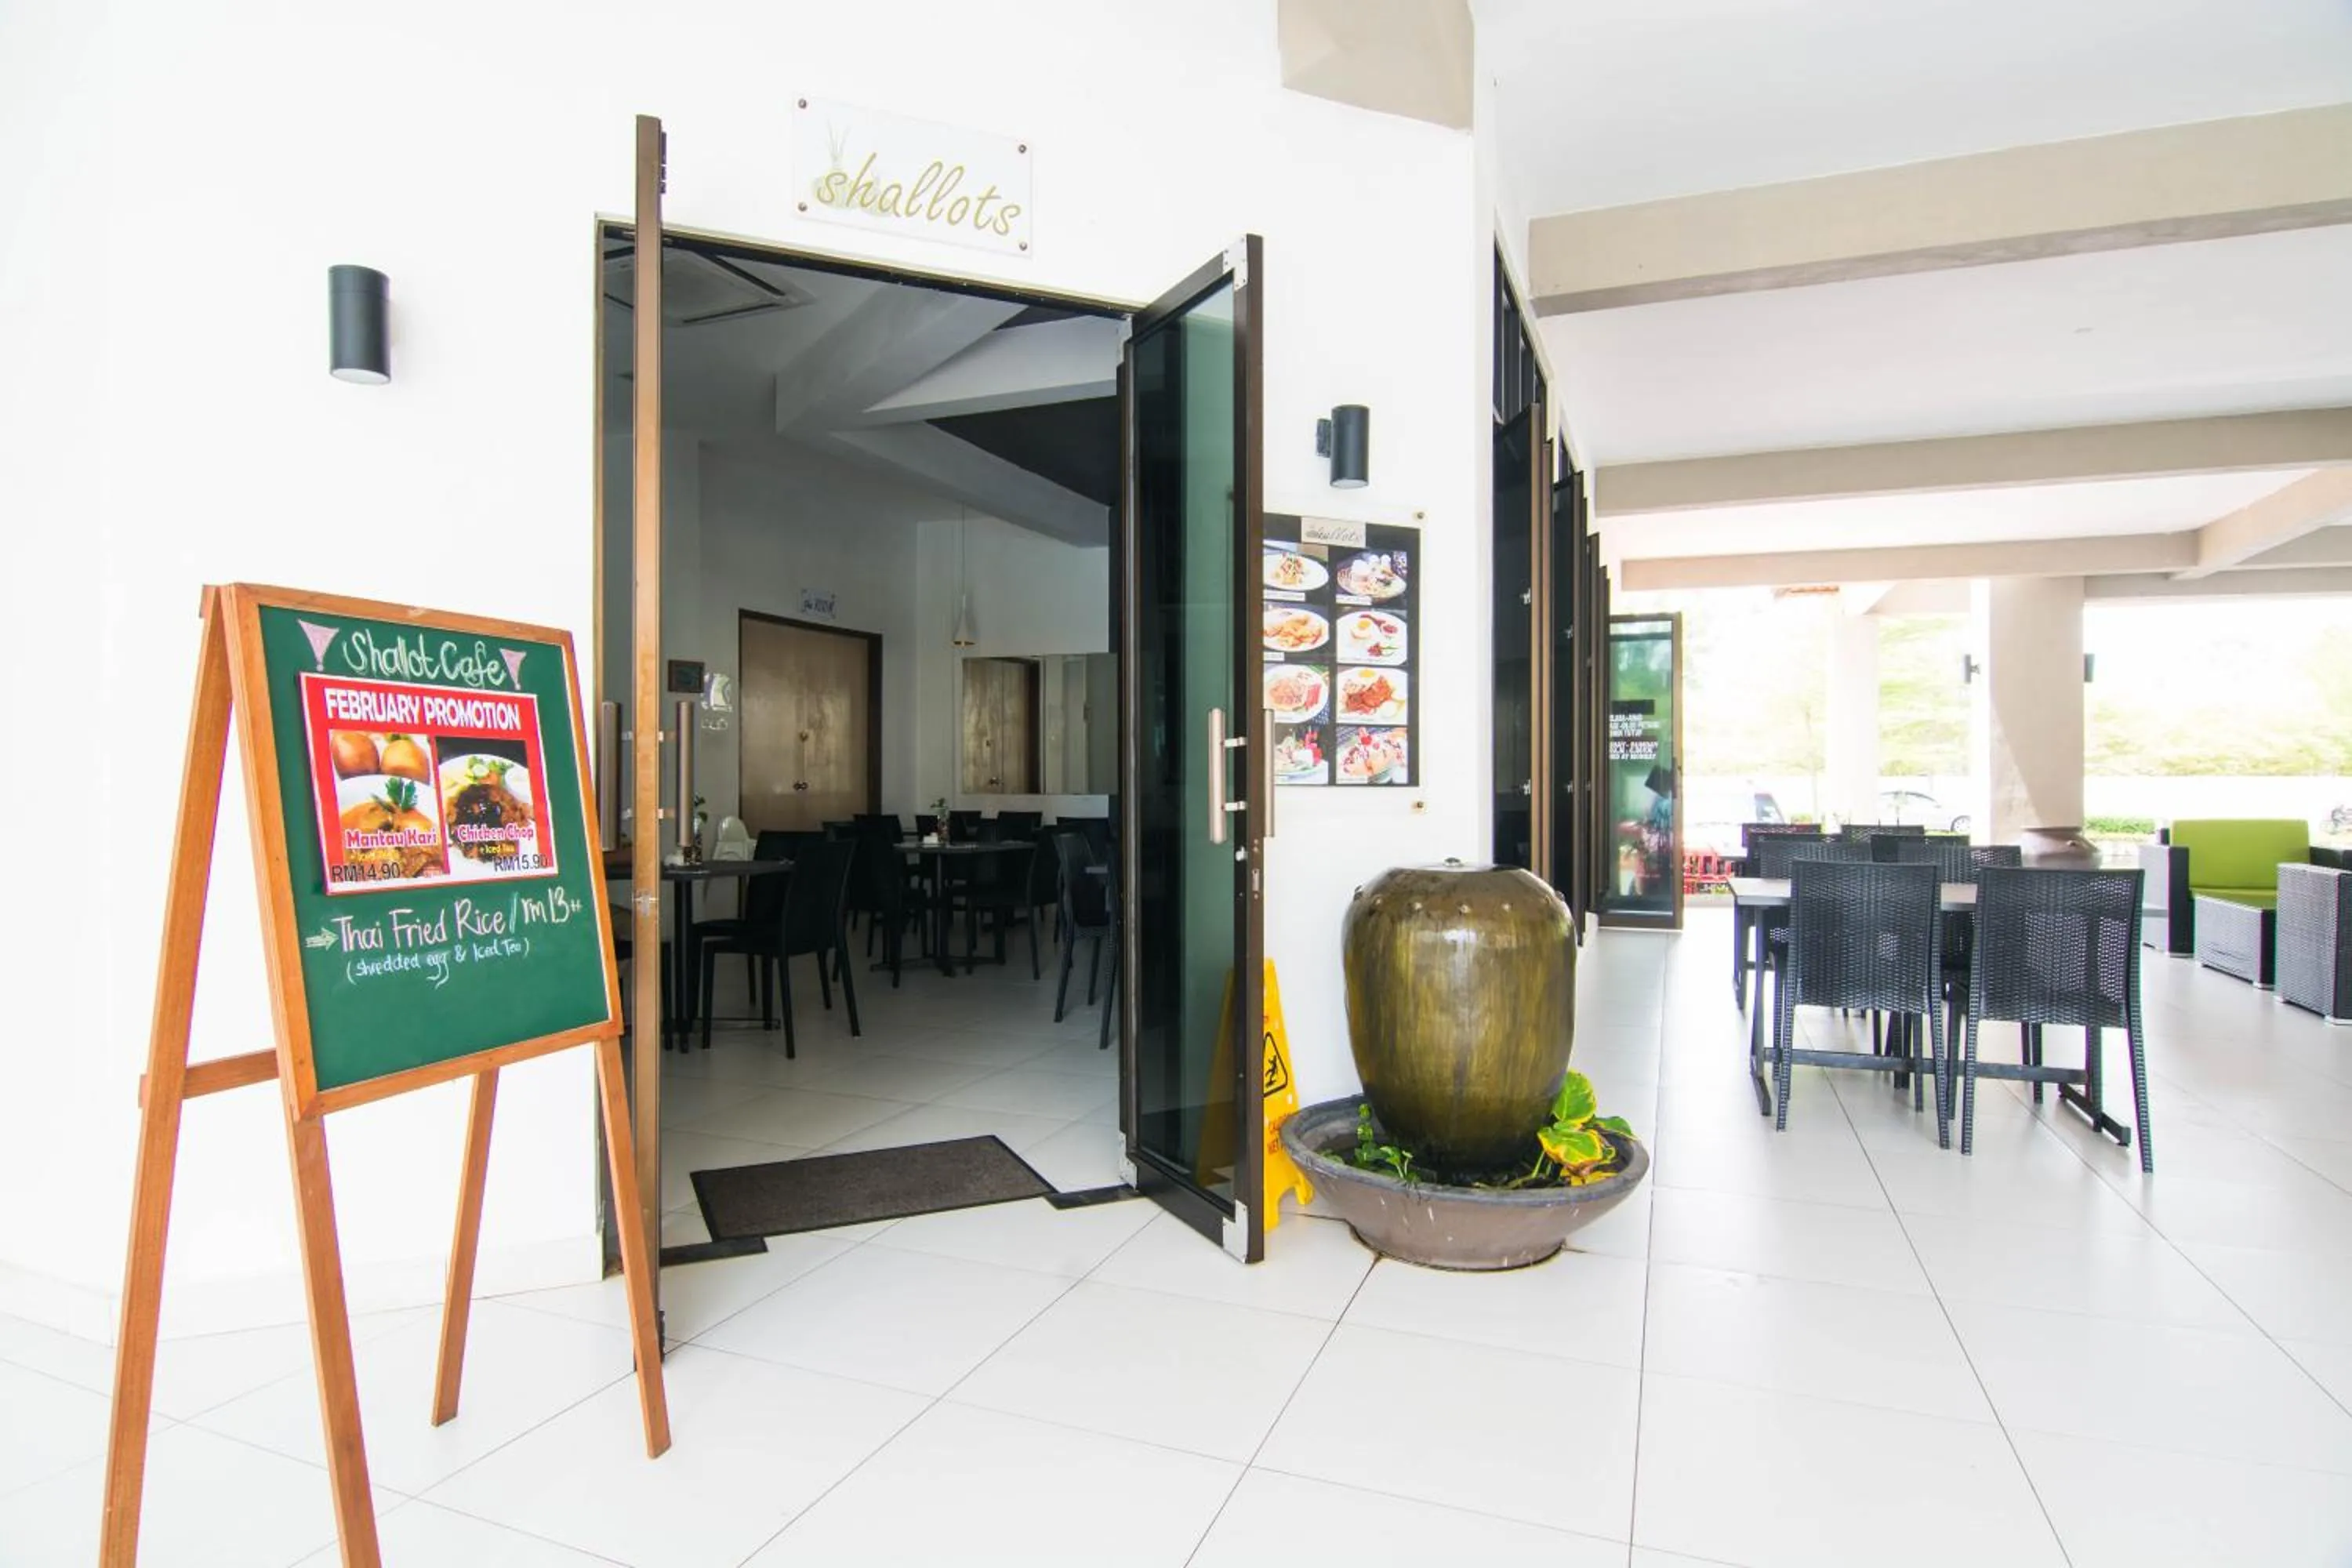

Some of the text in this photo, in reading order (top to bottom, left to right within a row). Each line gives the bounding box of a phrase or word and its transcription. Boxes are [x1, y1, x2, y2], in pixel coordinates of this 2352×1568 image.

[816, 151, 1022, 236] shallots
[342, 628, 506, 689] Shallot Cafe
[324, 687, 522, 731] FEBRUARY PROMOTION
[345, 827, 437, 848] Mantau Kari
[458, 822, 534, 842] Chicken Chop
[331, 862, 401, 883] RM14.90
[493, 853, 548, 873] RM15.90
[331, 915, 384, 953] Thai
[389, 909, 448, 949] Fried
[426, 949, 452, 989] egg
